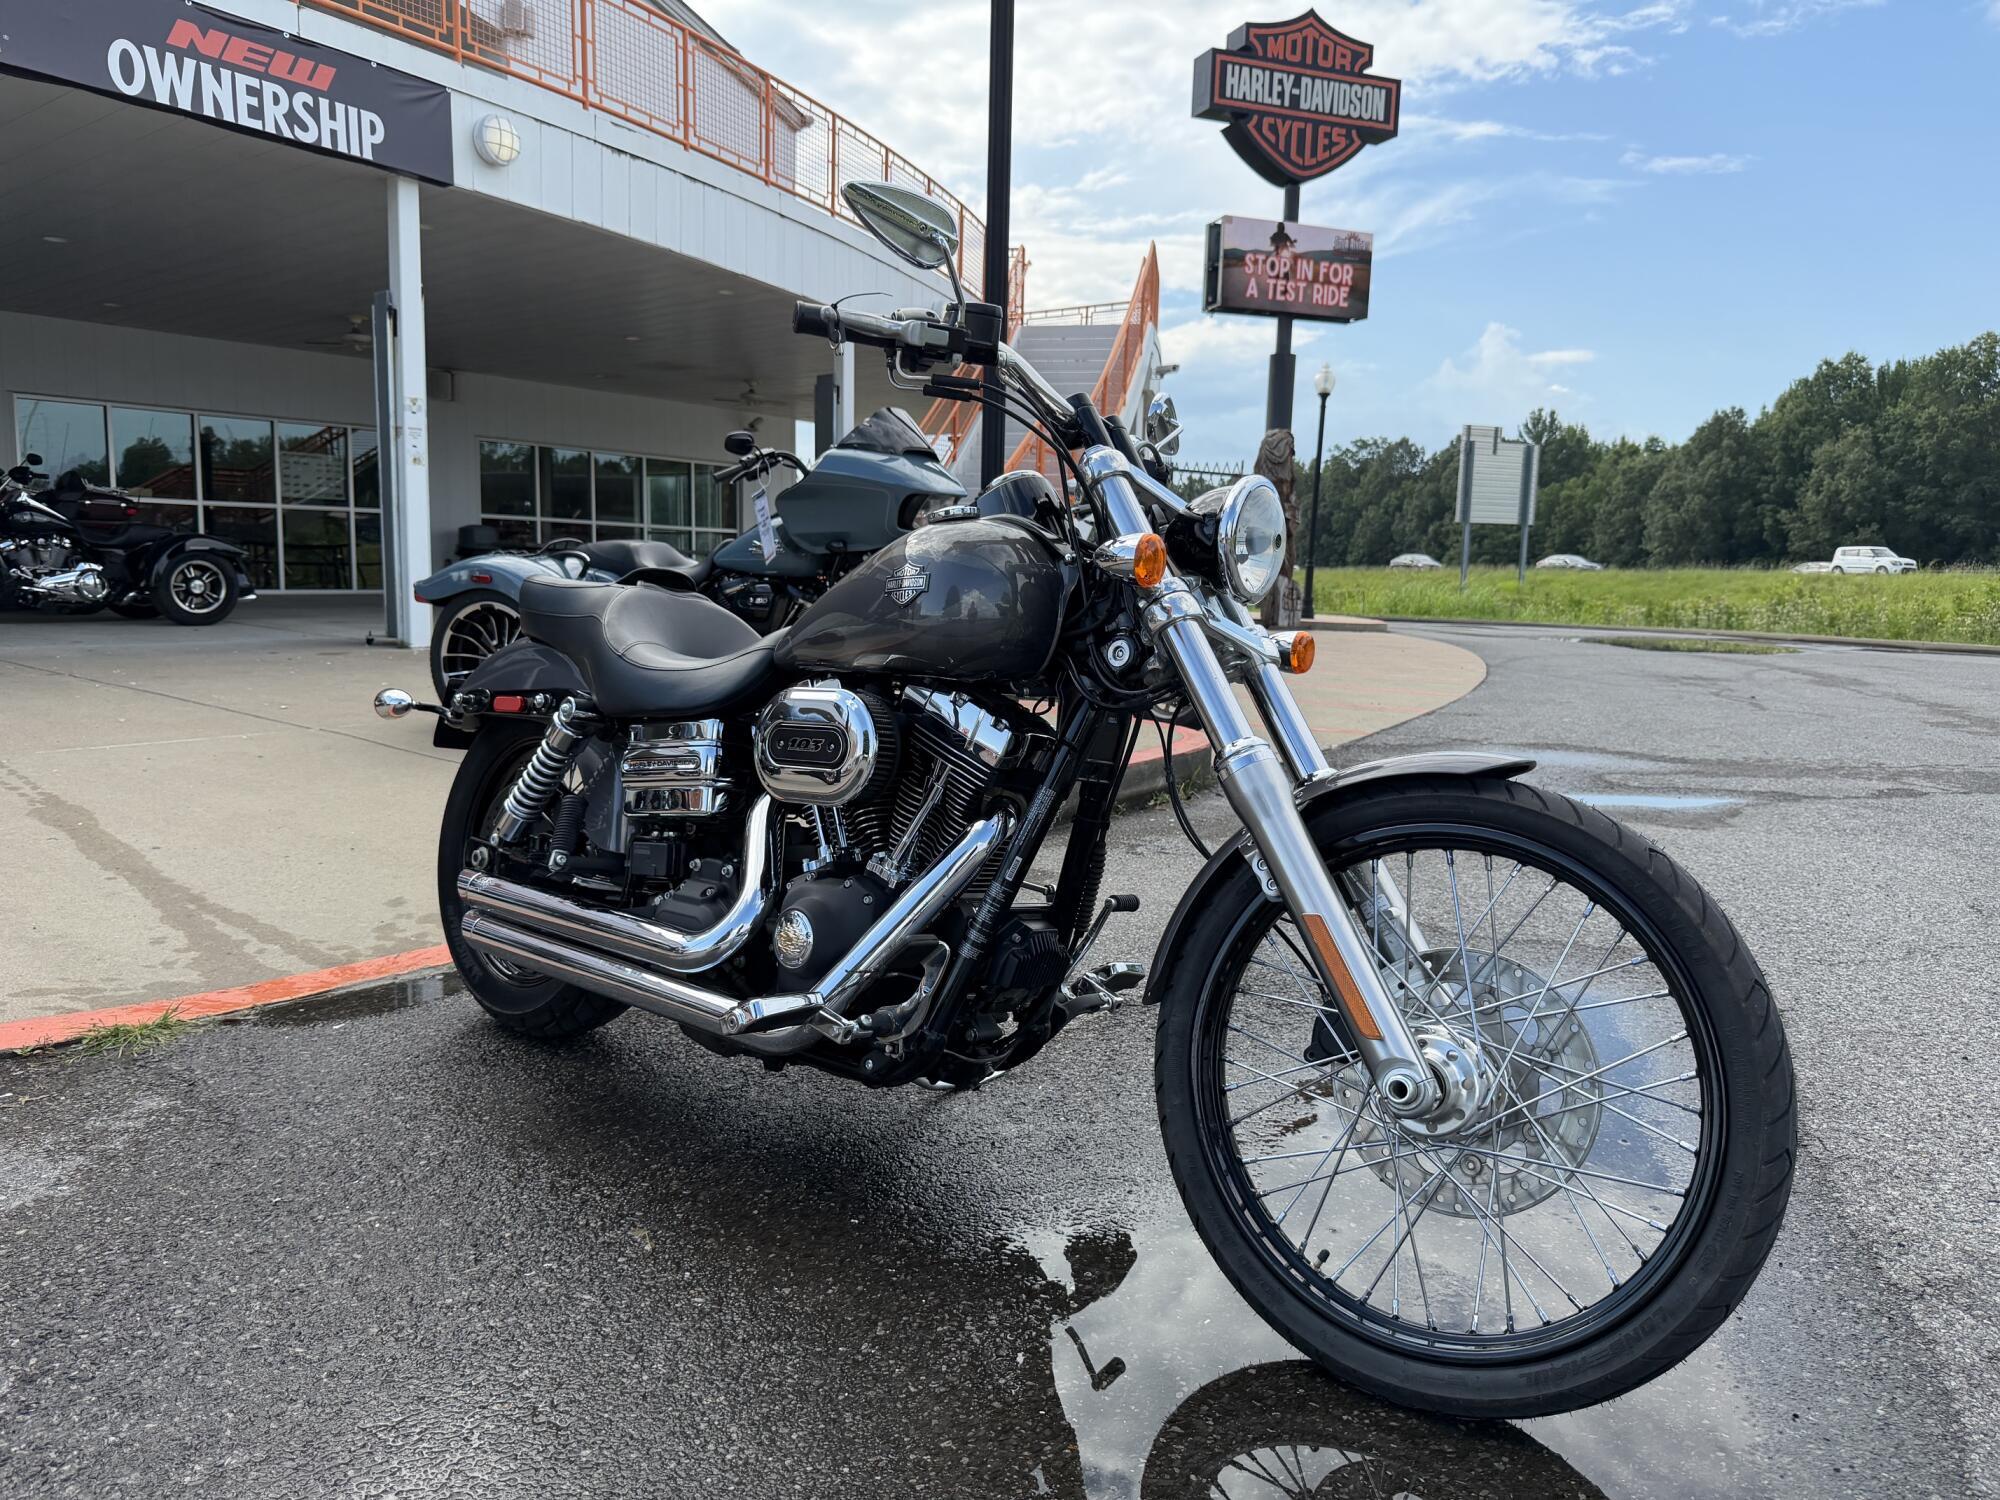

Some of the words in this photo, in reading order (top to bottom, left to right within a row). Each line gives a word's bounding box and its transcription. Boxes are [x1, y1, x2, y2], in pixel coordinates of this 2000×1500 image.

[166, 18, 337, 92] NEW
[1267, 26, 1352, 72] MOTOR
[107, 38, 386, 160] OWNERSHIP
[1225, 63, 1386, 122] HARLEY-DAVIDSON
[1262, 117, 1347, 167] CYCLES
[1244, 254, 1290, 278] STOP
[1296, 259, 1313, 281] IN
[1319, 261, 1353, 285] FOR
[1246, 278, 1258, 298] A
[1266, 278, 1307, 301] TEST
[1312, 283, 1350, 307] RIDE
[787, 737, 825, 752] 103
